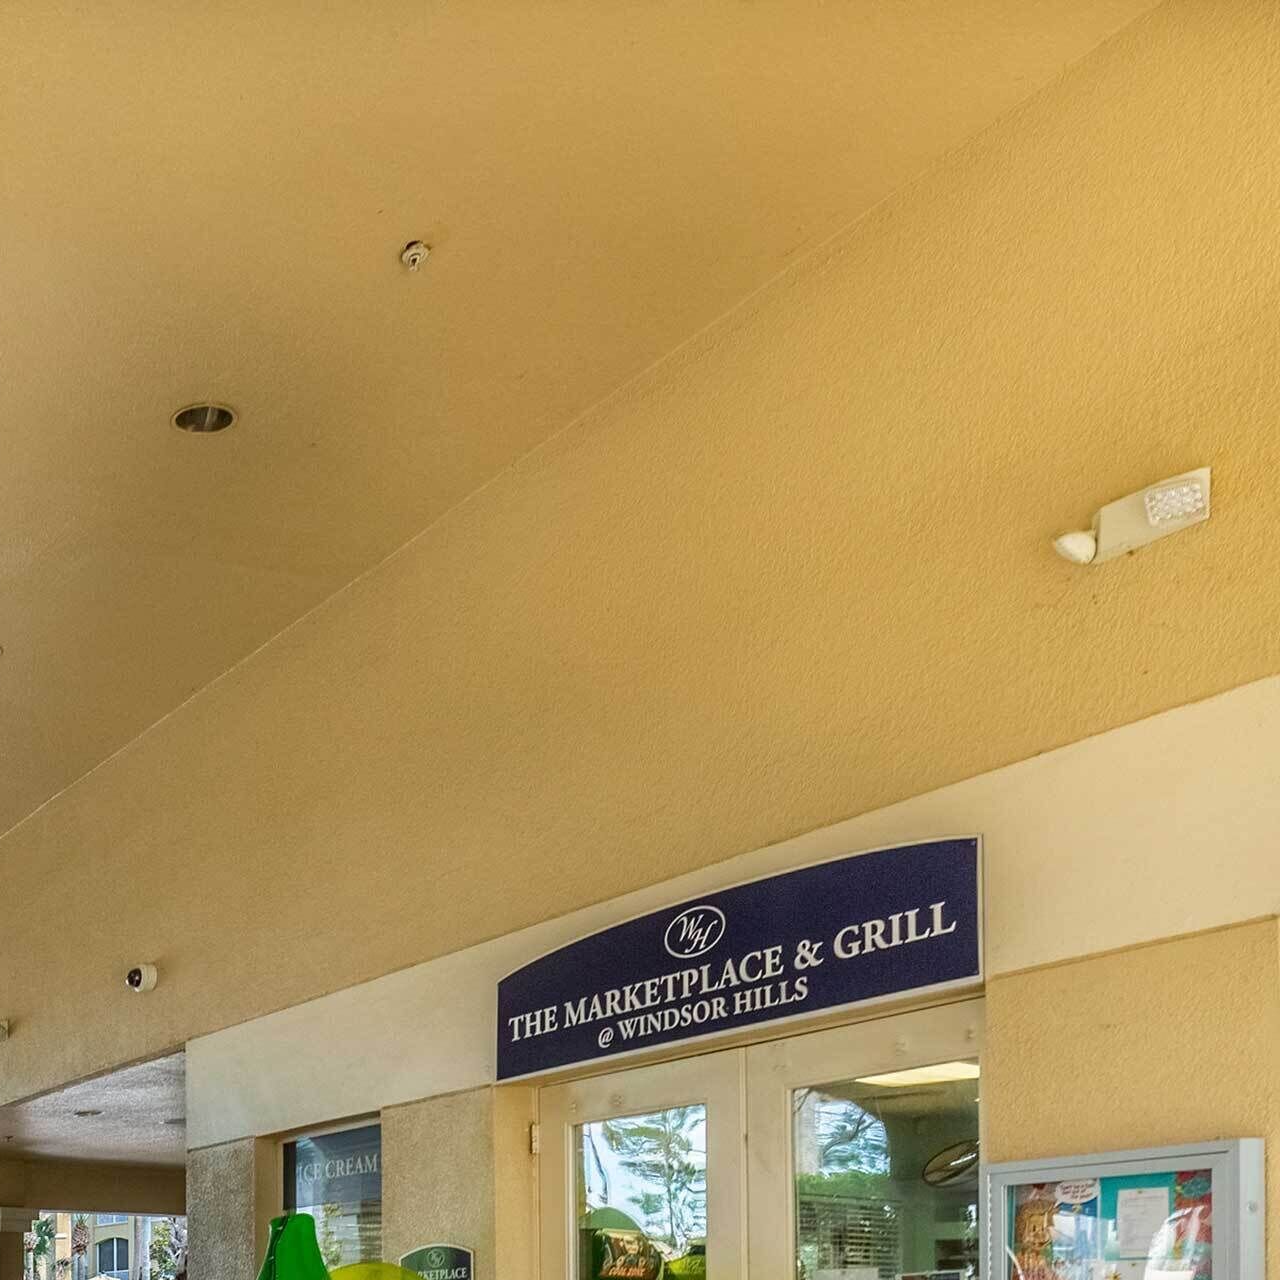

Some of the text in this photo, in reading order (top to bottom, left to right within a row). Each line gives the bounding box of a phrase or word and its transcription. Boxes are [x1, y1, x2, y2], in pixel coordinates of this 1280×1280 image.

[509, 901, 956, 1042] THE MARKETPLACE & GRILL
[597, 976, 809, 1048] @ WINDSOR HILLS
[297, 1154, 378, 1182] ICE CREAM
